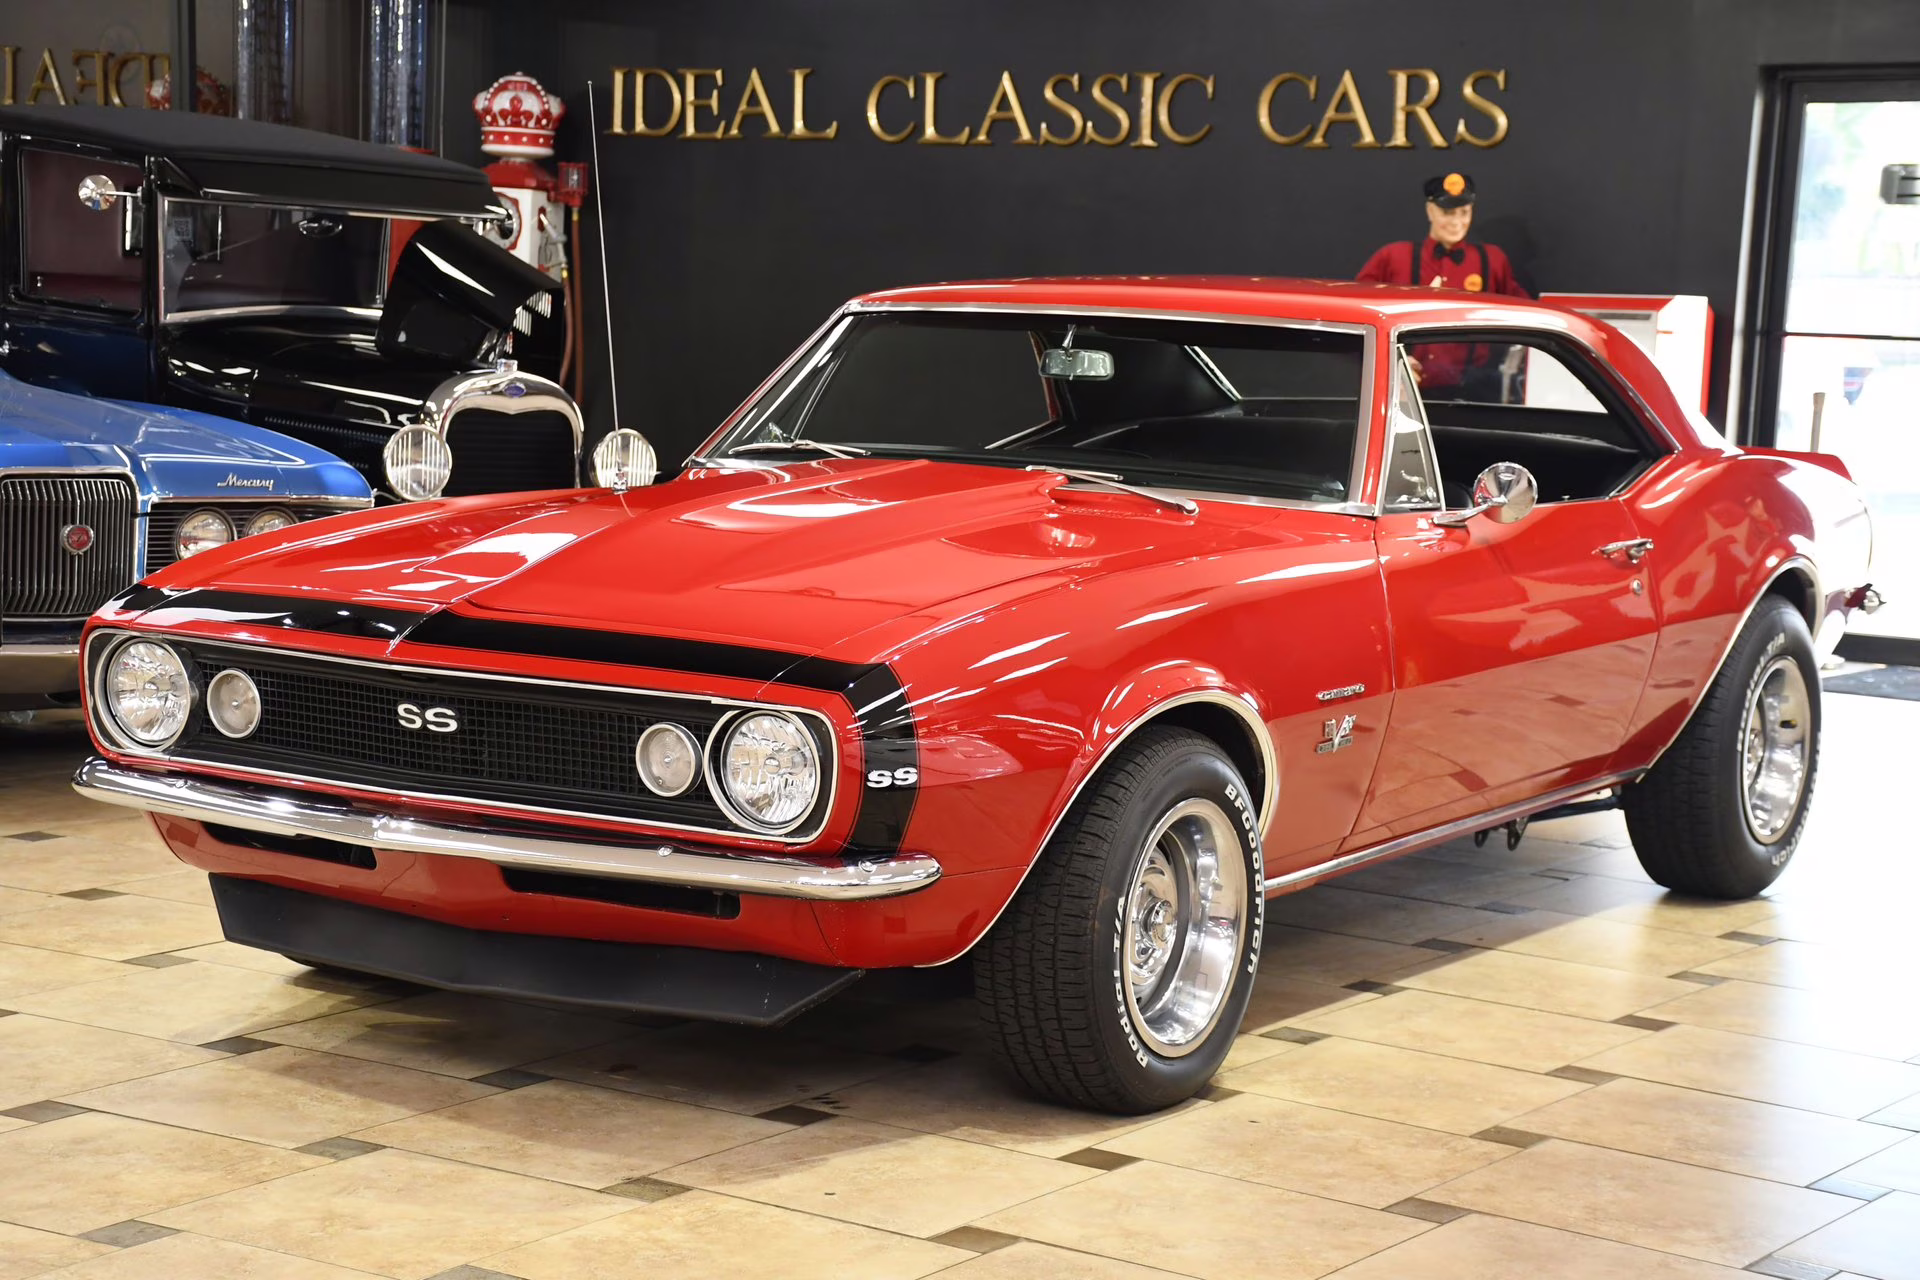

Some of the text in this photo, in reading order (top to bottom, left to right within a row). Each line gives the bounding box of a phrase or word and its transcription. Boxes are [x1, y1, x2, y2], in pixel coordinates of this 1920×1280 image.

[603, 67, 1509, 147] IDEAL CLASSIC CARS
[217, 472, 274, 491] Mercury
[397, 703, 458, 732] SS
[866, 767, 918, 788] SS
[1224, 783, 1262, 975] BFGoodrich
[1113, 896, 1149, 1068] Radial T/A
